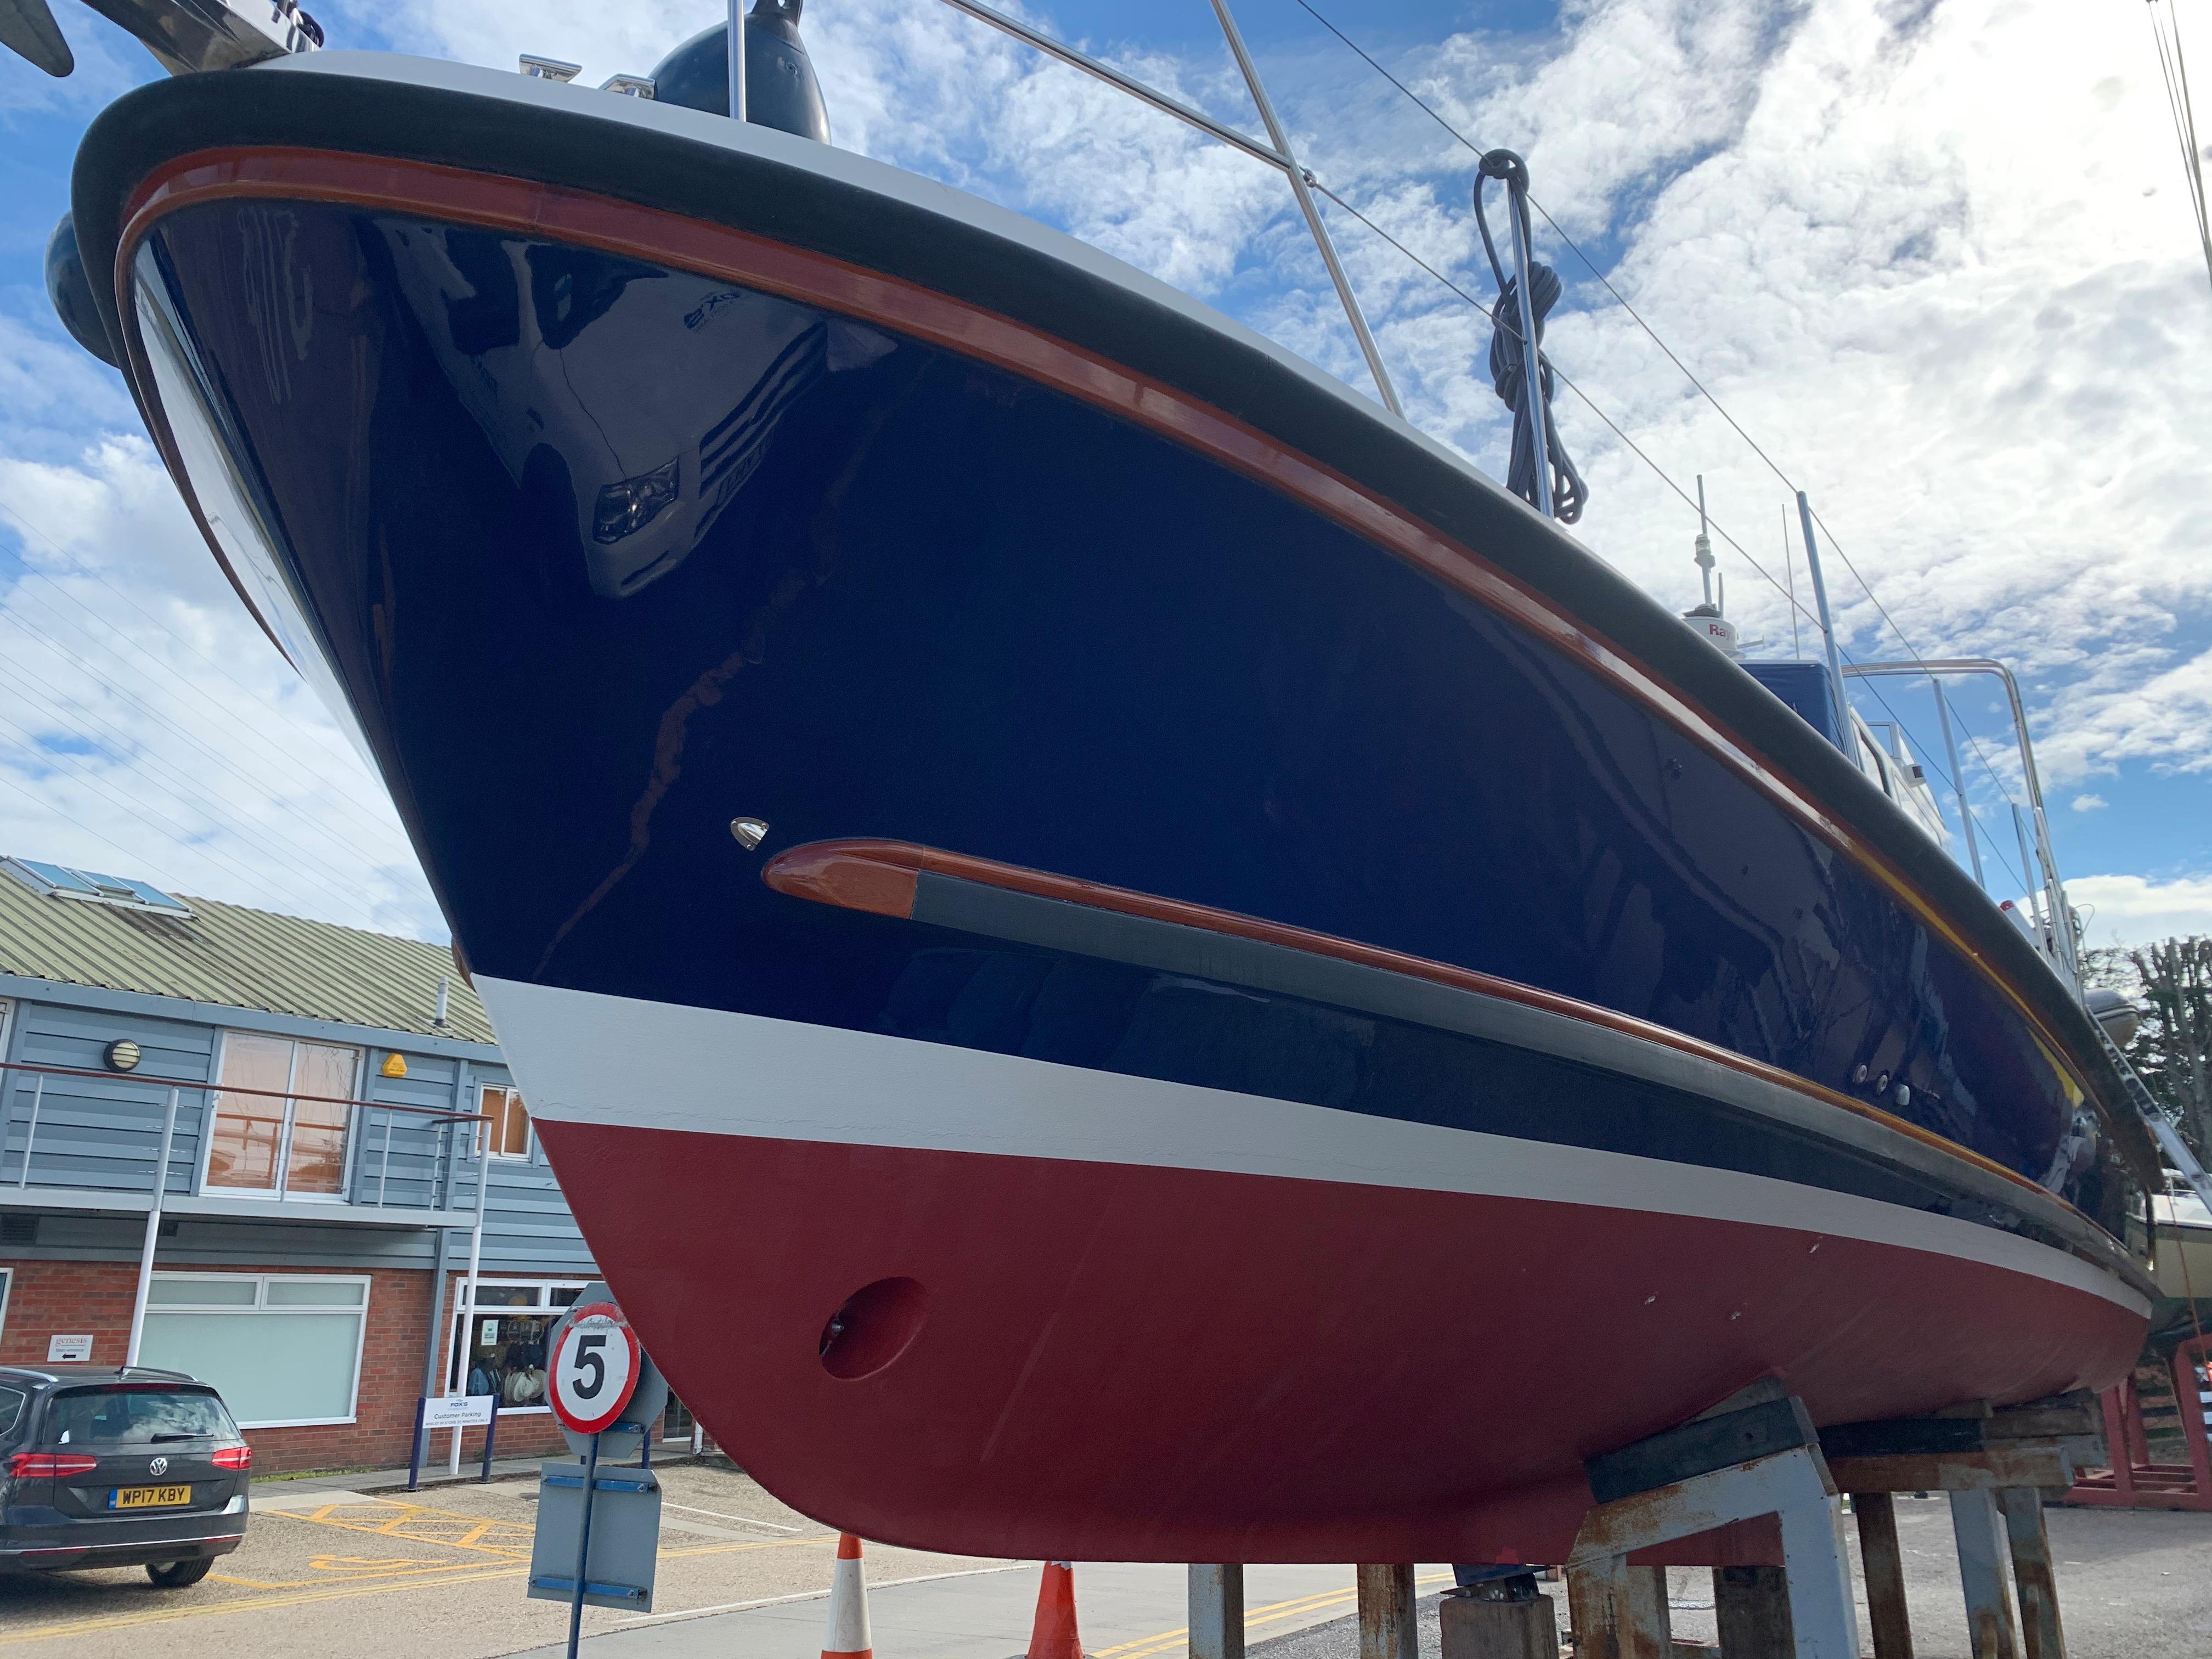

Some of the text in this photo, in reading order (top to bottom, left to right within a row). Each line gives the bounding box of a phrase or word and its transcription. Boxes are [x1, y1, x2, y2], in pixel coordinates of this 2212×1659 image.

[55, 1339, 87, 1347] genesis
[572, 1335, 607, 1400] 5
[122, 1487, 185, 1504] WP17 KBY
